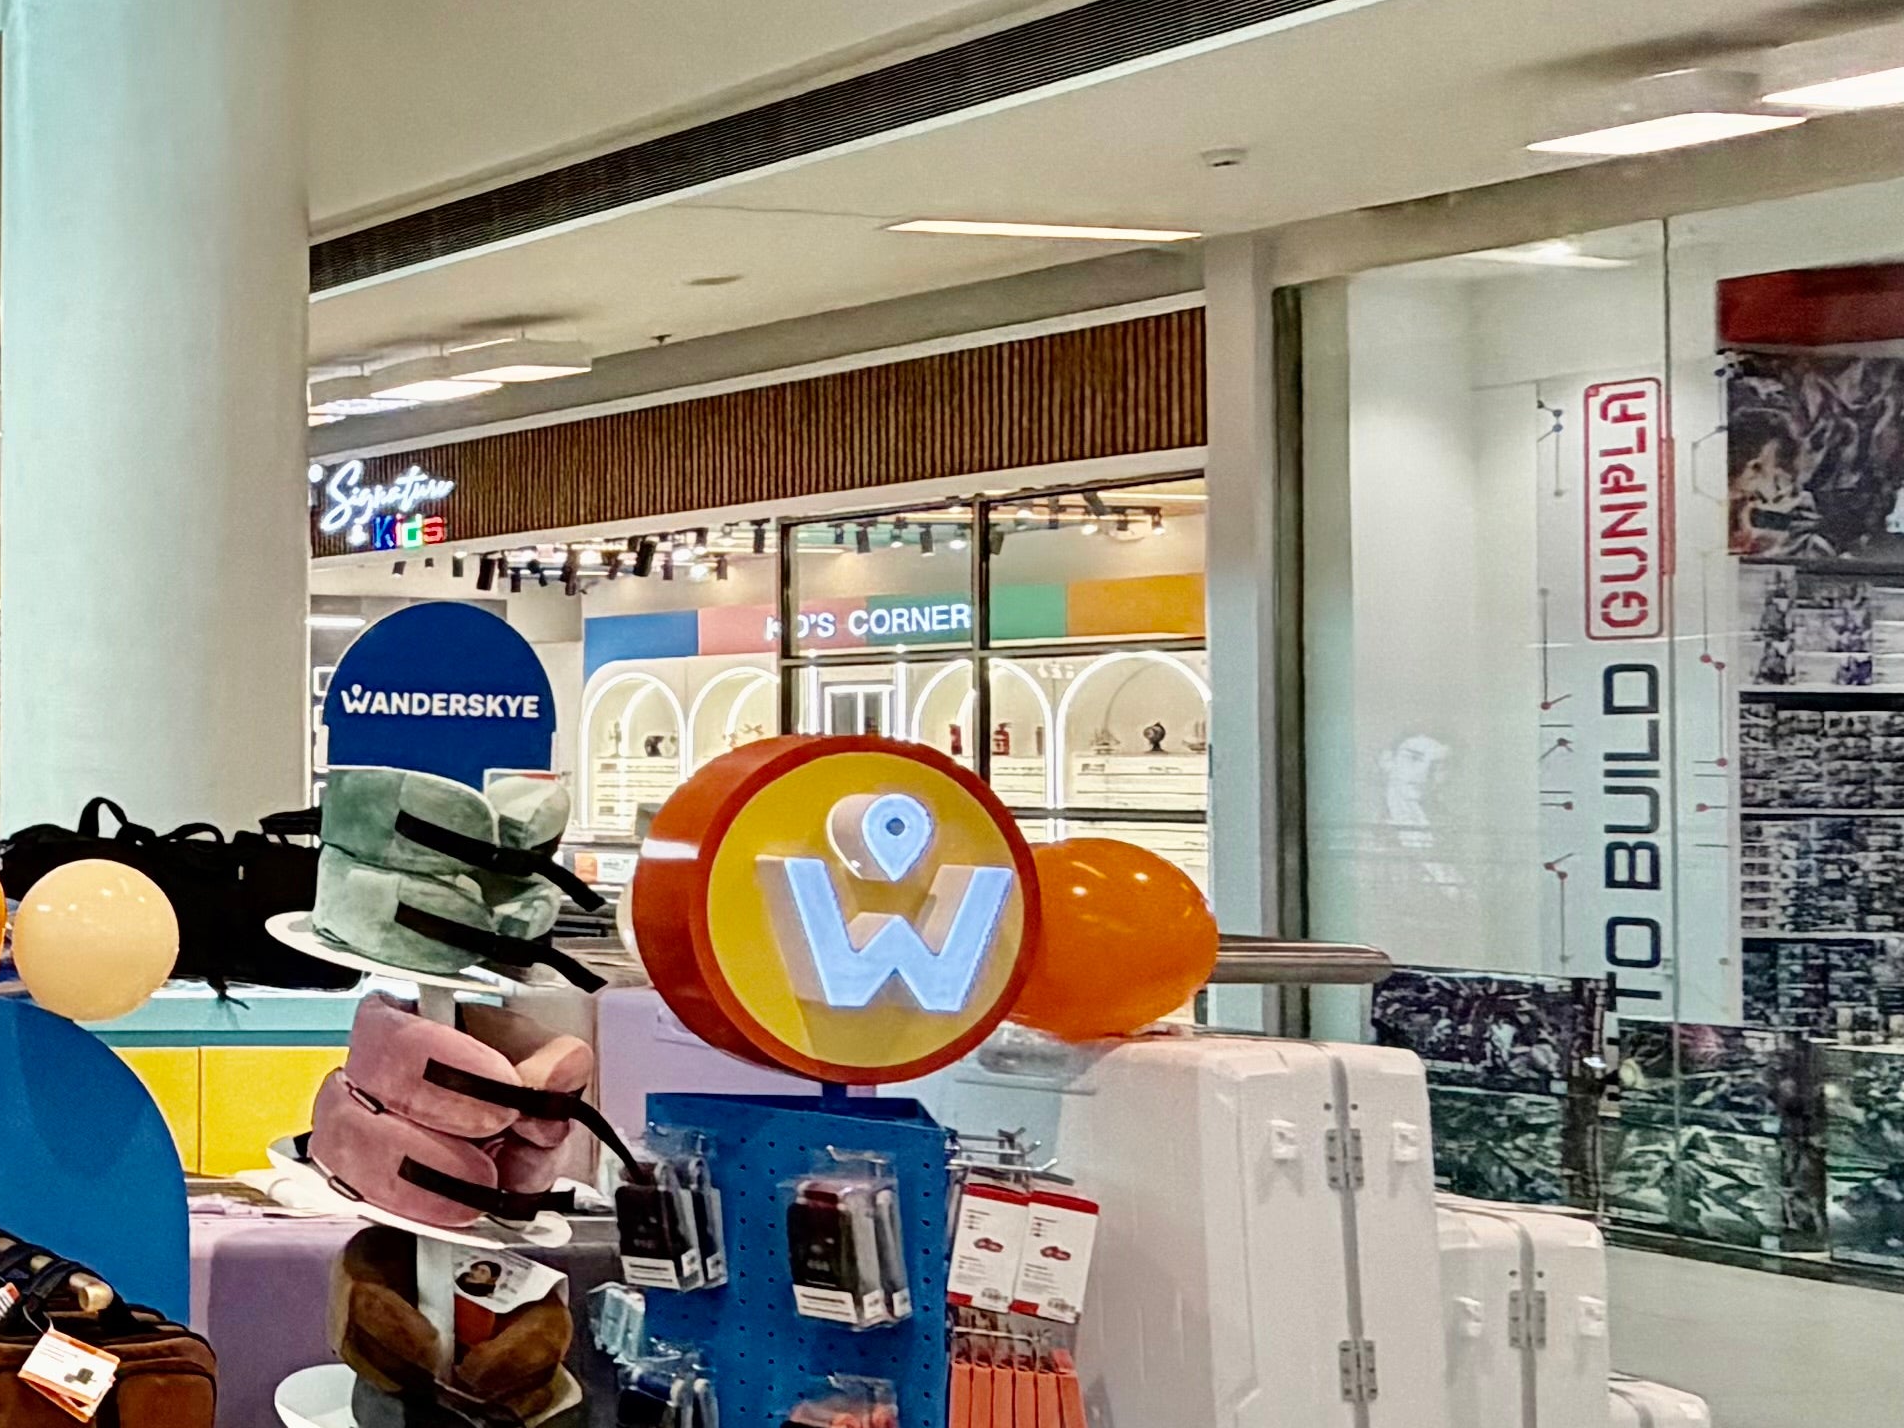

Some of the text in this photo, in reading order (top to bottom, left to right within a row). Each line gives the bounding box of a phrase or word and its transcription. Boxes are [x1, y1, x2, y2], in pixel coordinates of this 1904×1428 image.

[320, 459, 456, 533] Signature
[373, 513, 448, 551] Kids
[765, 603, 973, 640] KD'S CORNER
[339, 684, 540, 718] WANDERSKYE
[1598, 390, 1662, 1012] TO BUILD GUNPLA
